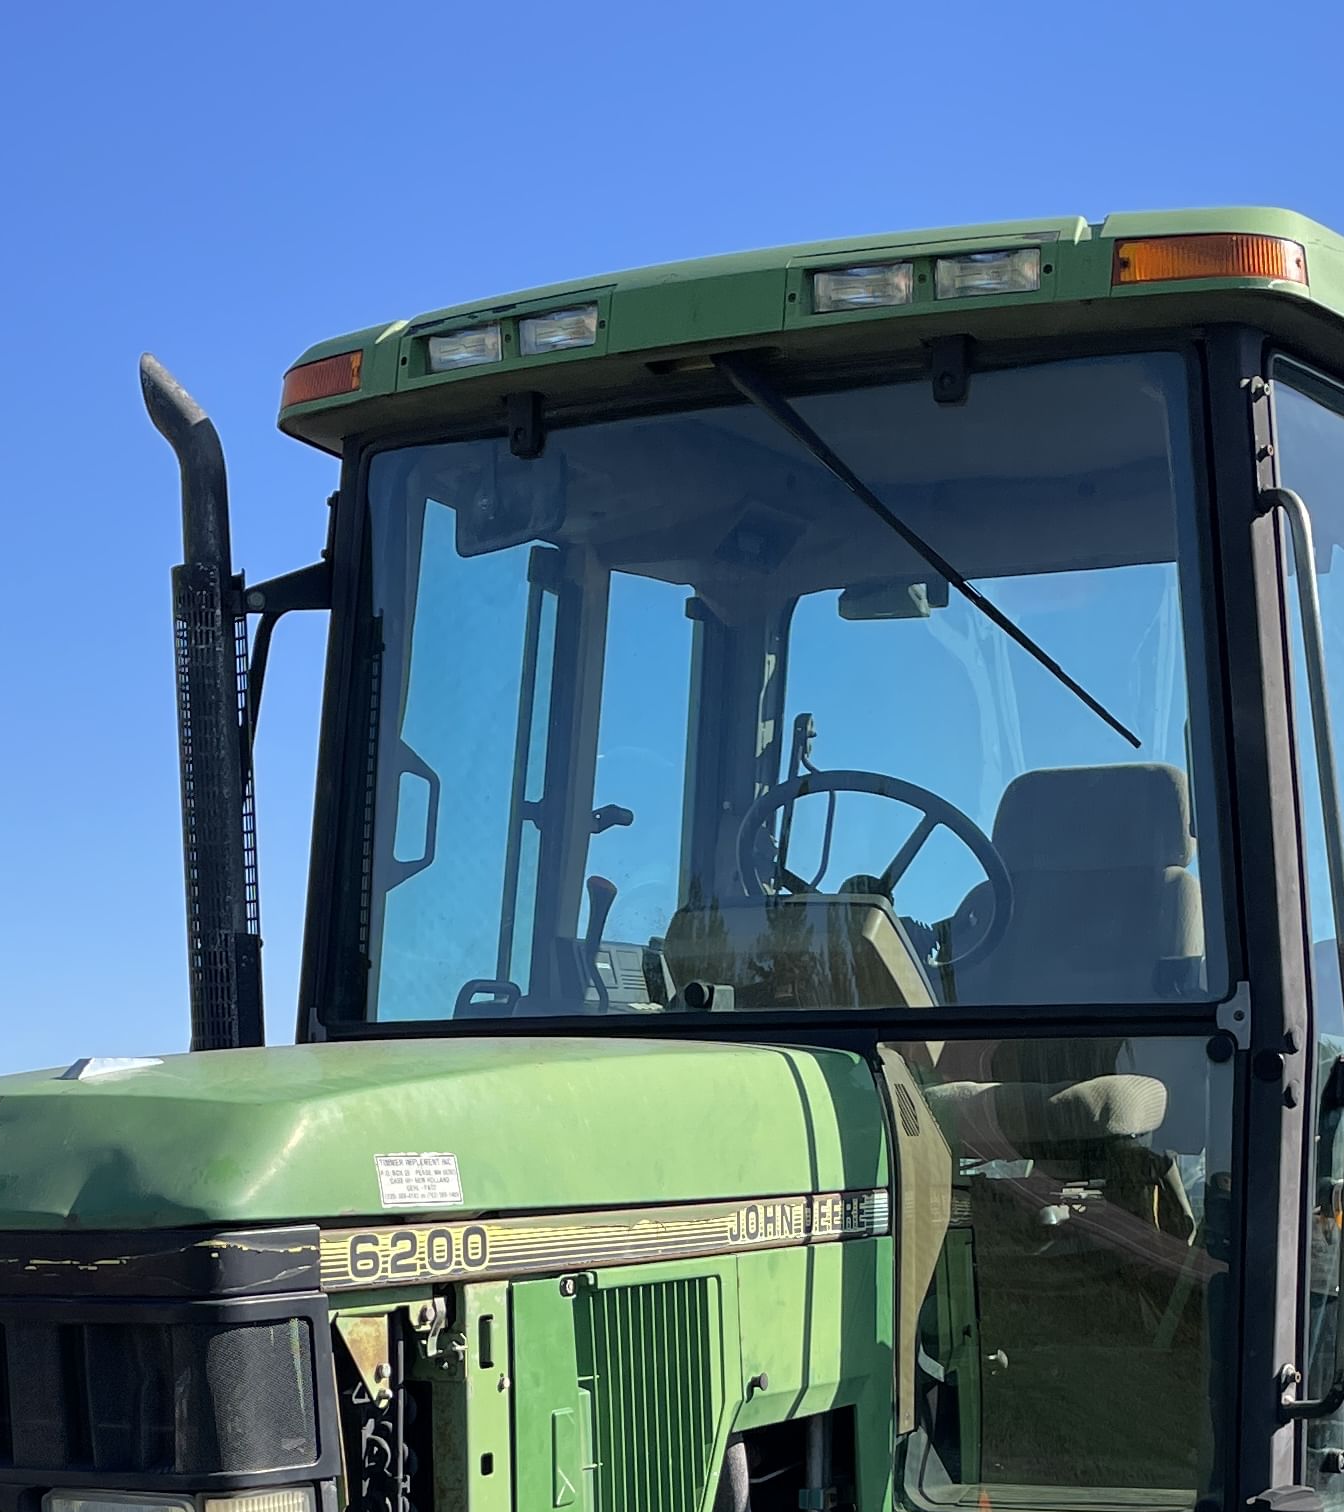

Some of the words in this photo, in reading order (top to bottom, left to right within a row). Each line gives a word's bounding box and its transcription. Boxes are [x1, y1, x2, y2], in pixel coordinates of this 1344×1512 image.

[728, 1204, 794, 1242] JOHN
[802, 1196, 867, 1236] DEERE
[348, 1225, 488, 1281] 6200
